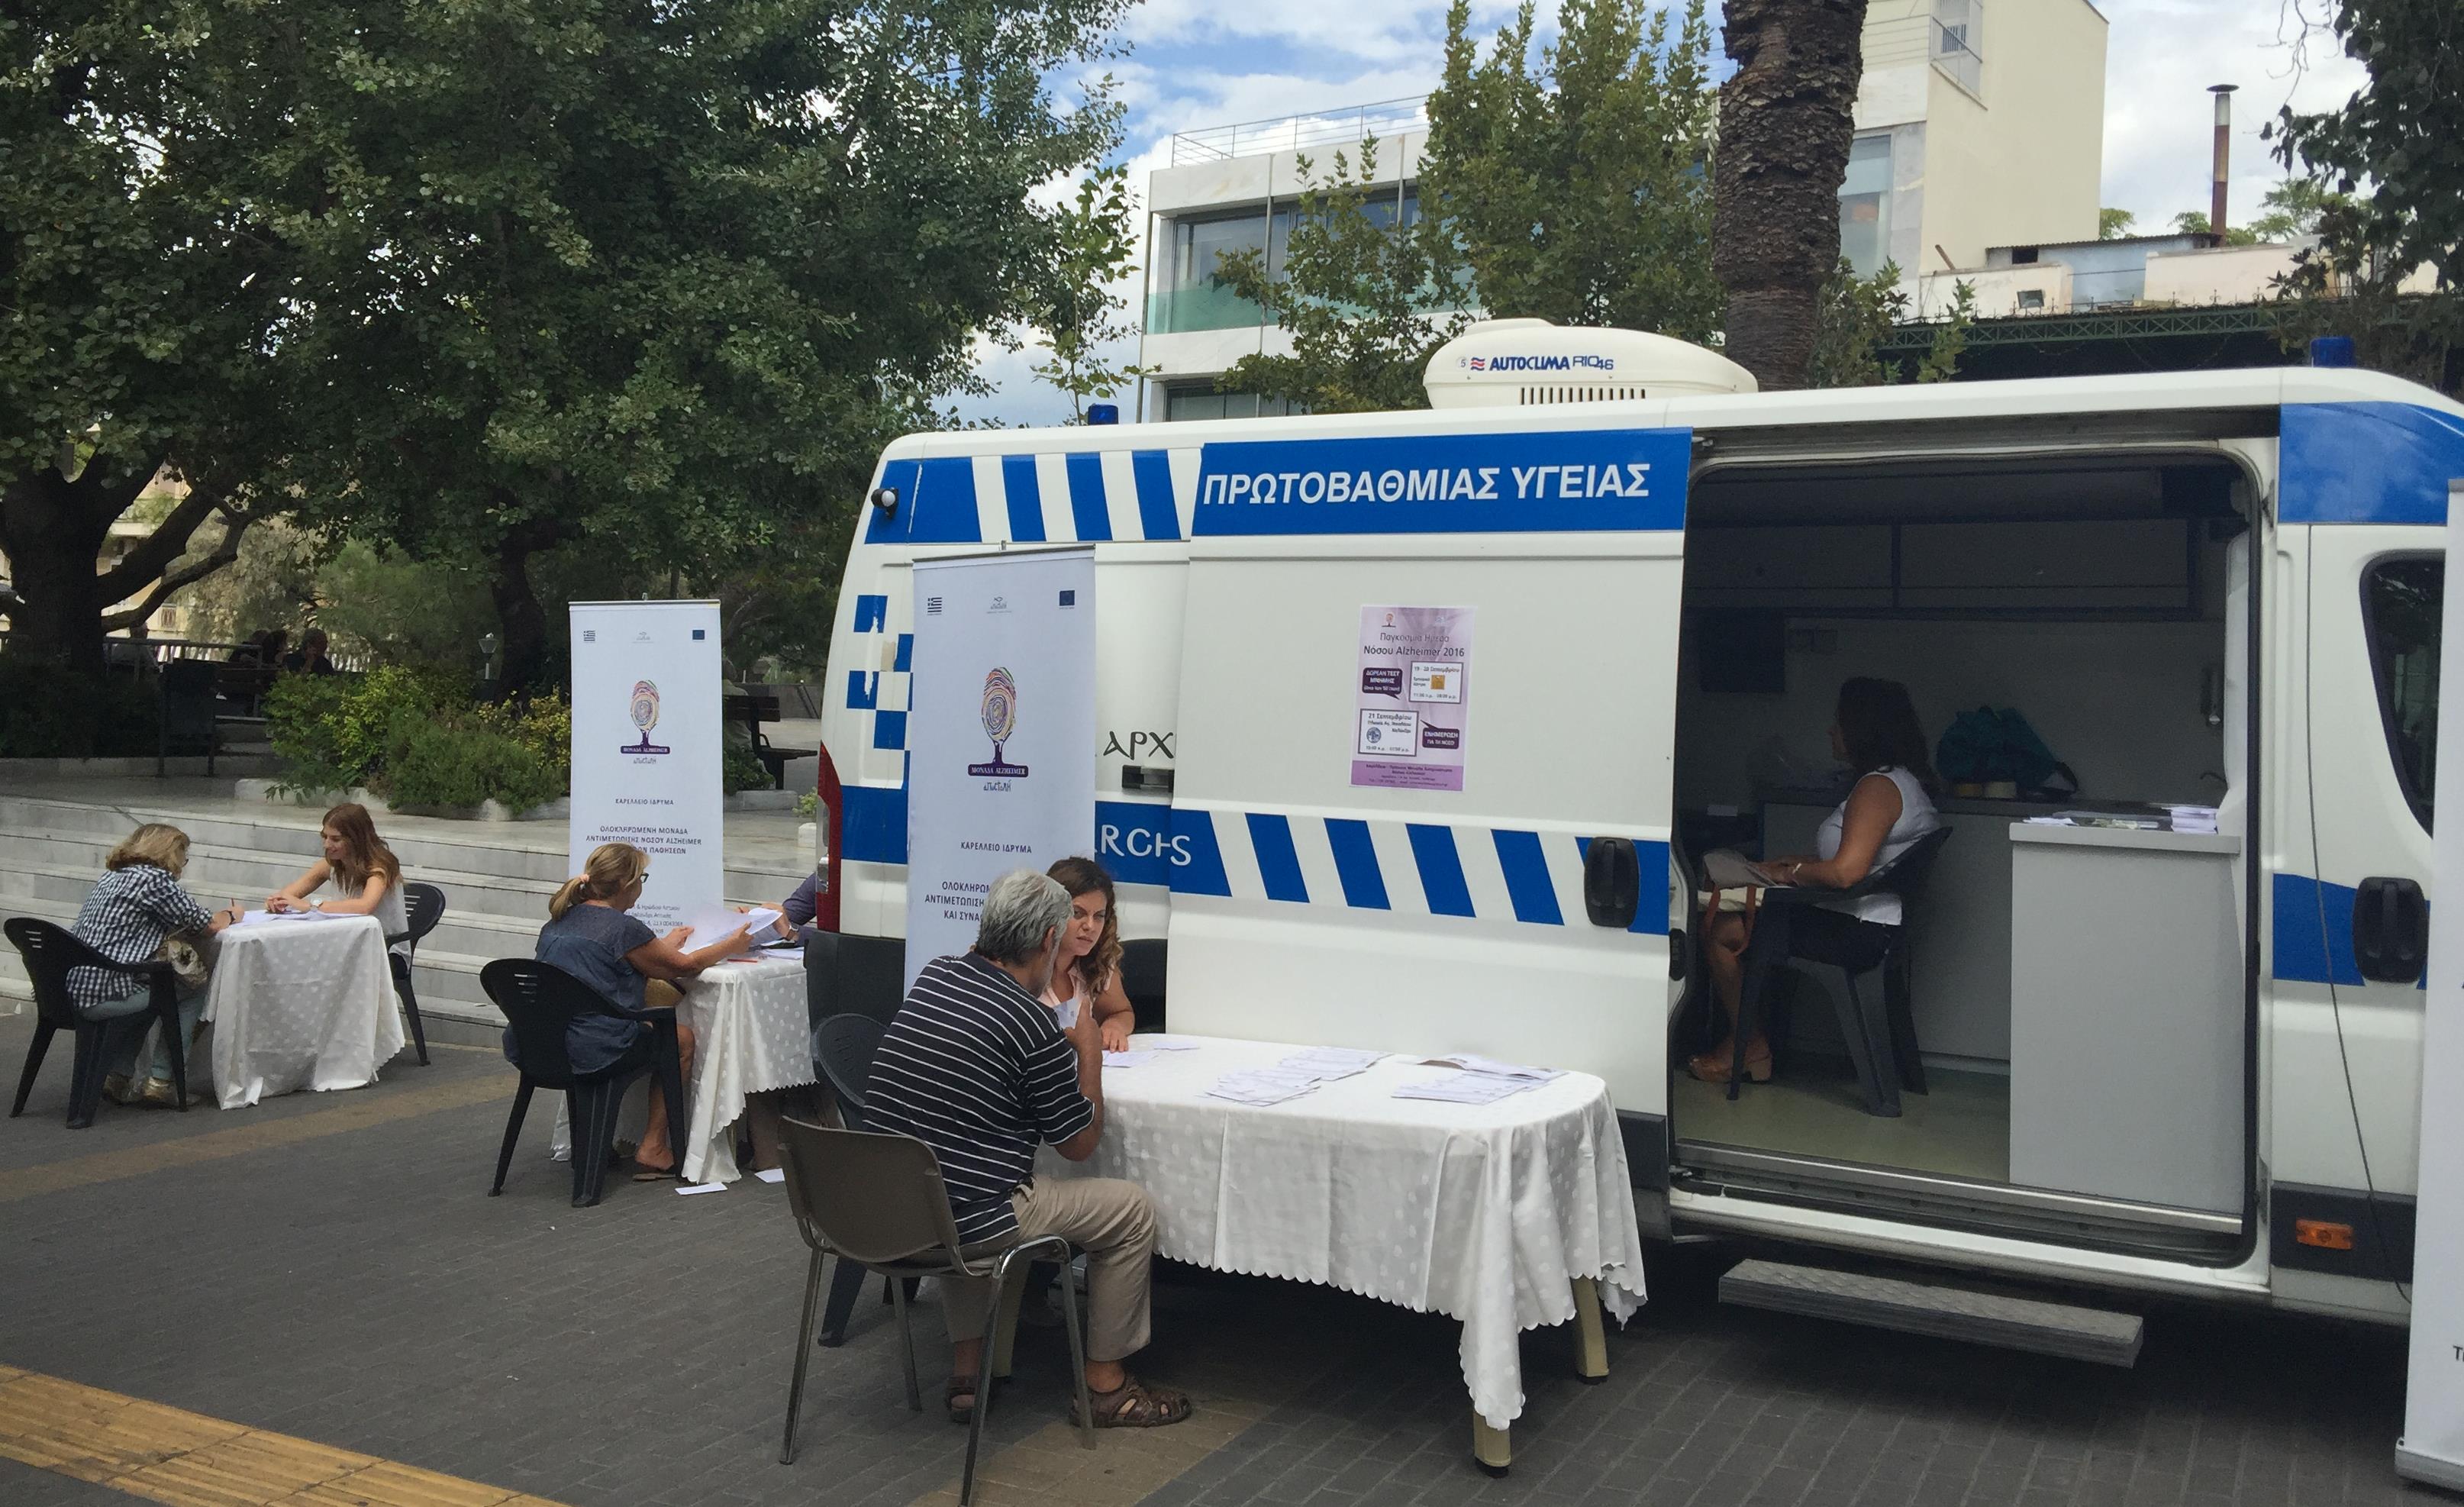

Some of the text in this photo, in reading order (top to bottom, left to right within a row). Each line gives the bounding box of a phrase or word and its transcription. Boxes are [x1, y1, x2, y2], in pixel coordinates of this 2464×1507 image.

[1489, 356, 1570, 371] AUTOCLIMA
[1203, 463, 1650, 505] ΠΡΩΤΟΒΑΘΜΙΑΣ ΥΓΕΙΑΣ
[1363, 644, 1465, 657] Νόσου Alzheimer 2016
[1103, 731, 1174, 760] ΑΡΧ
[960, 842, 1032, 854] ΚΑΡΕΛΛΕΙΟ ΙΔΡΥΜΑ
[943, 910, 982, 921] ΚΑΙ ΣΥΝΑ
